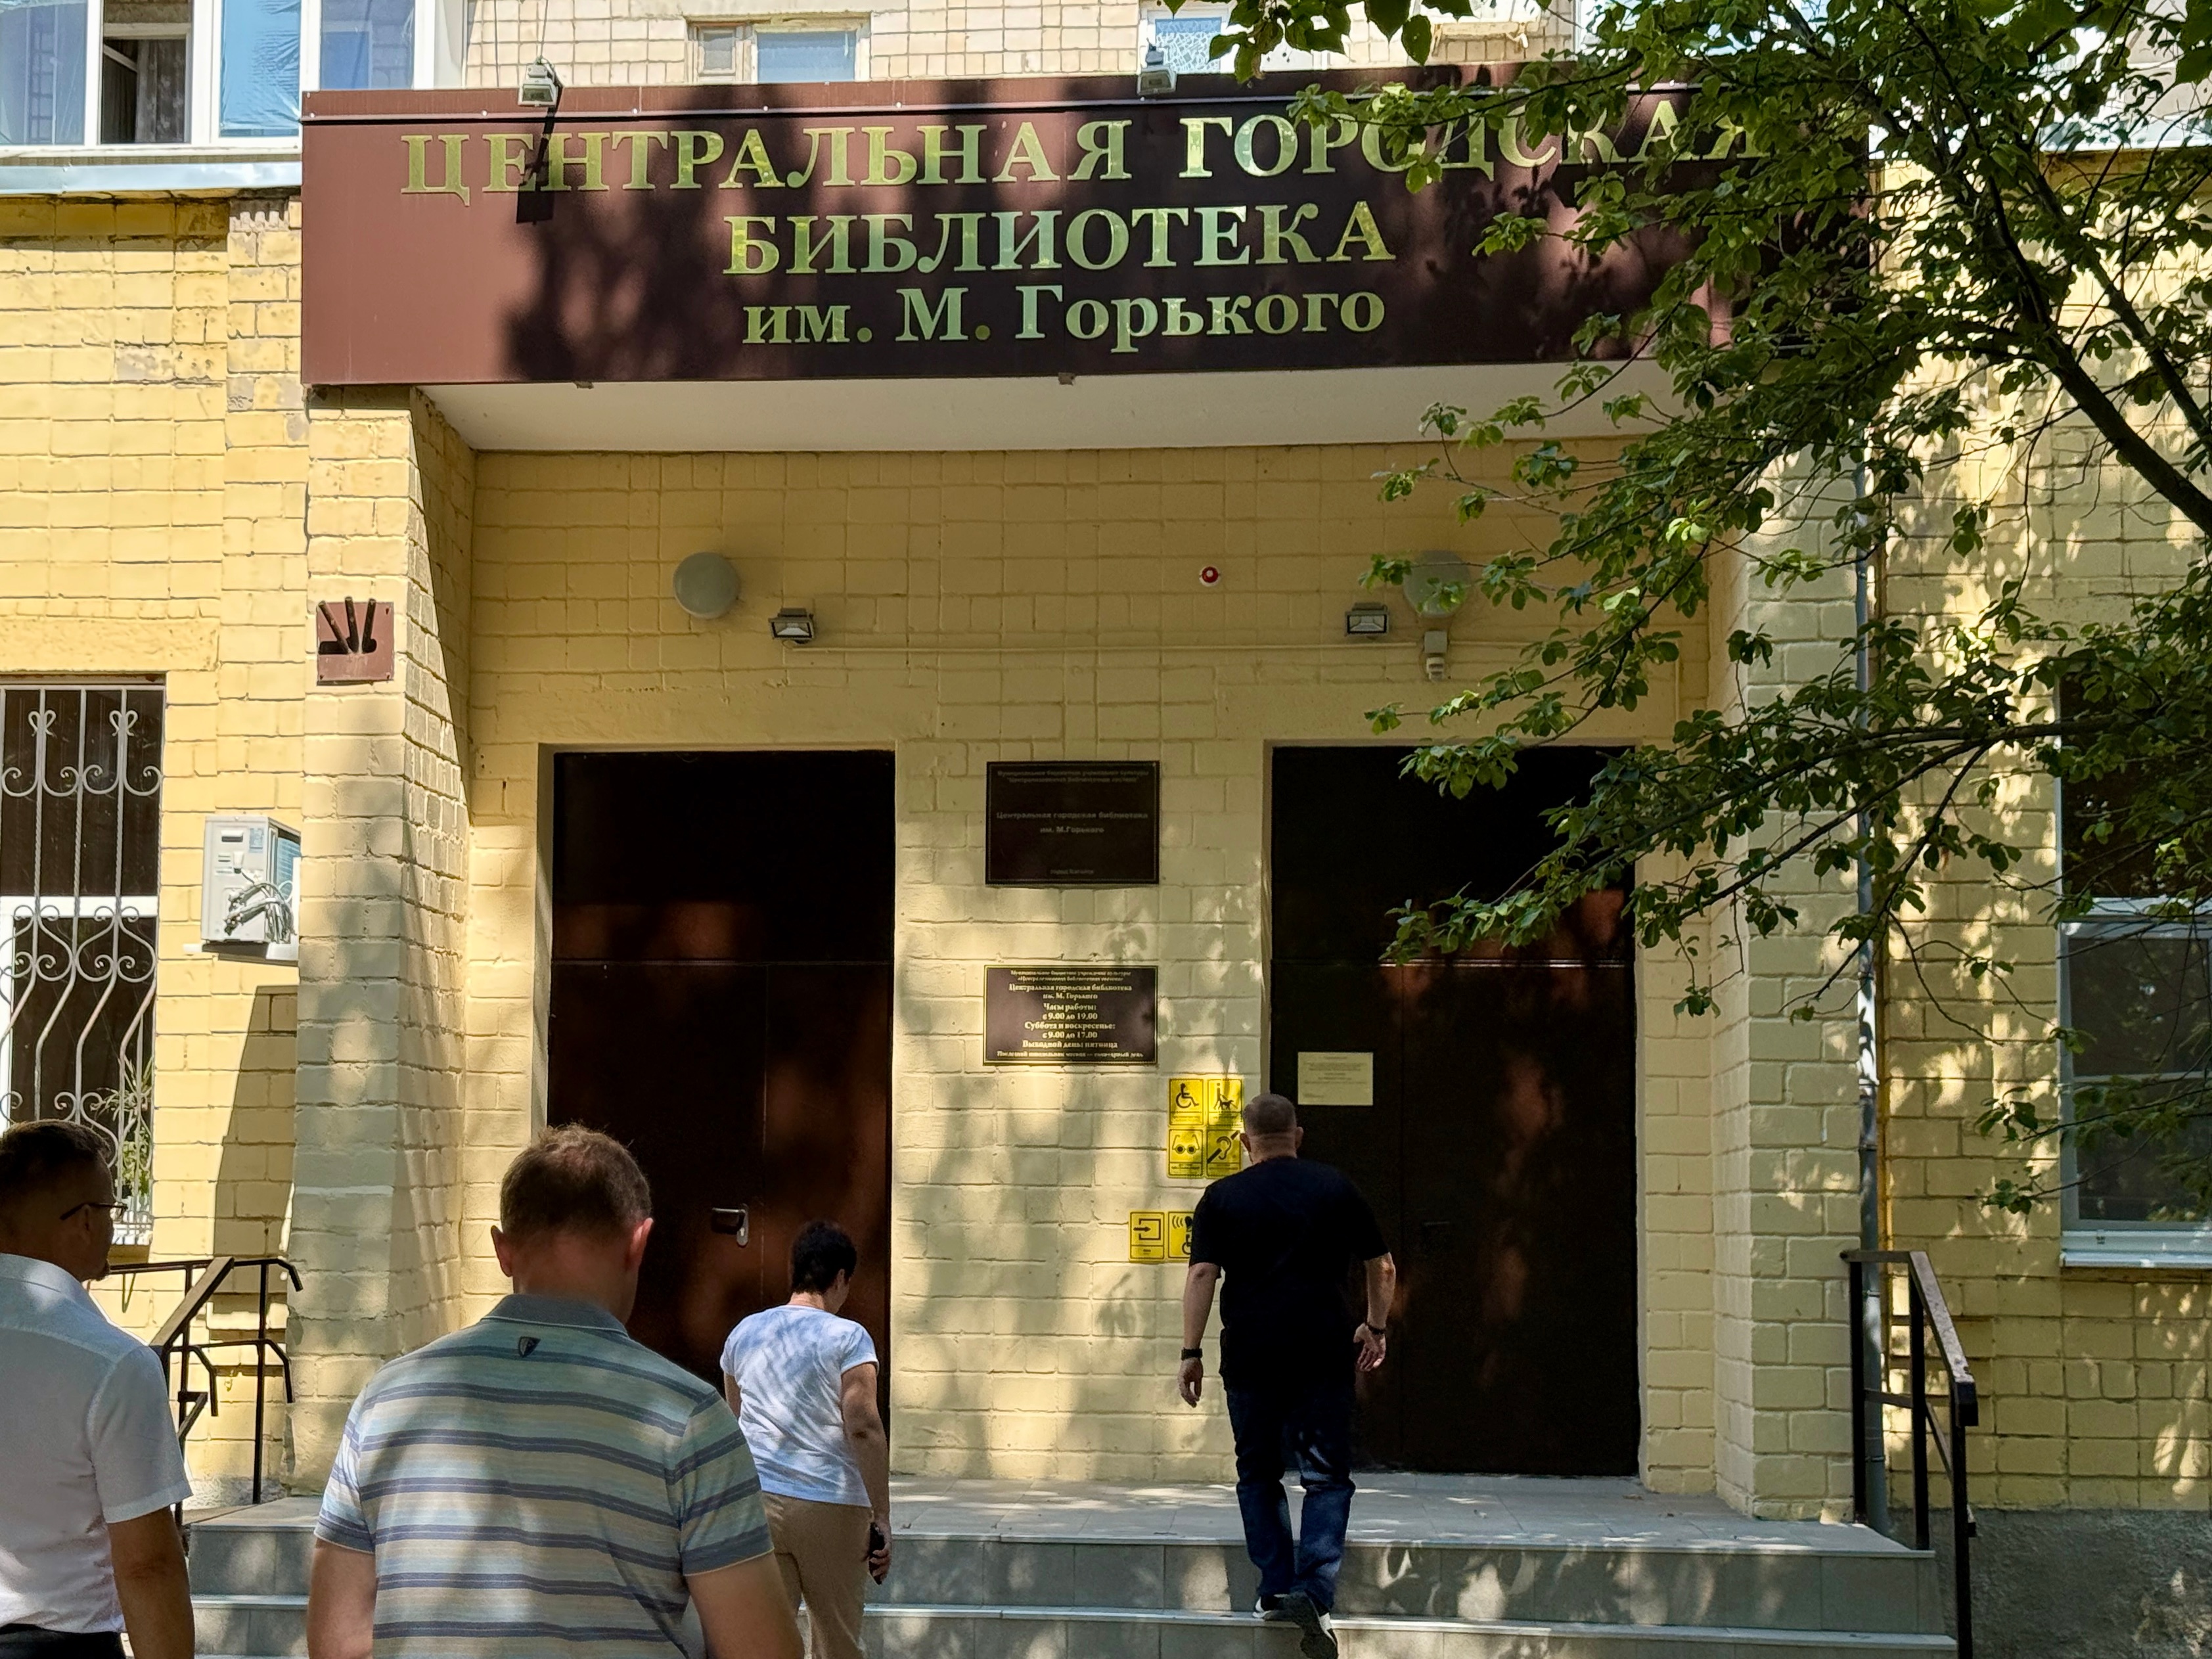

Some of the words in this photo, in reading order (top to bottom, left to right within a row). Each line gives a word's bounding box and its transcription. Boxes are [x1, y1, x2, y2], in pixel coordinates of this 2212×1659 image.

[400, 119, 1133, 206] ЦЕНТРАЛЬНАЯ
[723, 200, 1396, 275] БИБЛИОТЕКА
[742, 305, 873, 344] им.
[895, 286, 991, 342] М.
[1014, 284, 1386, 353] Горького
[1024, 1022, 1058, 1031] Суббота
